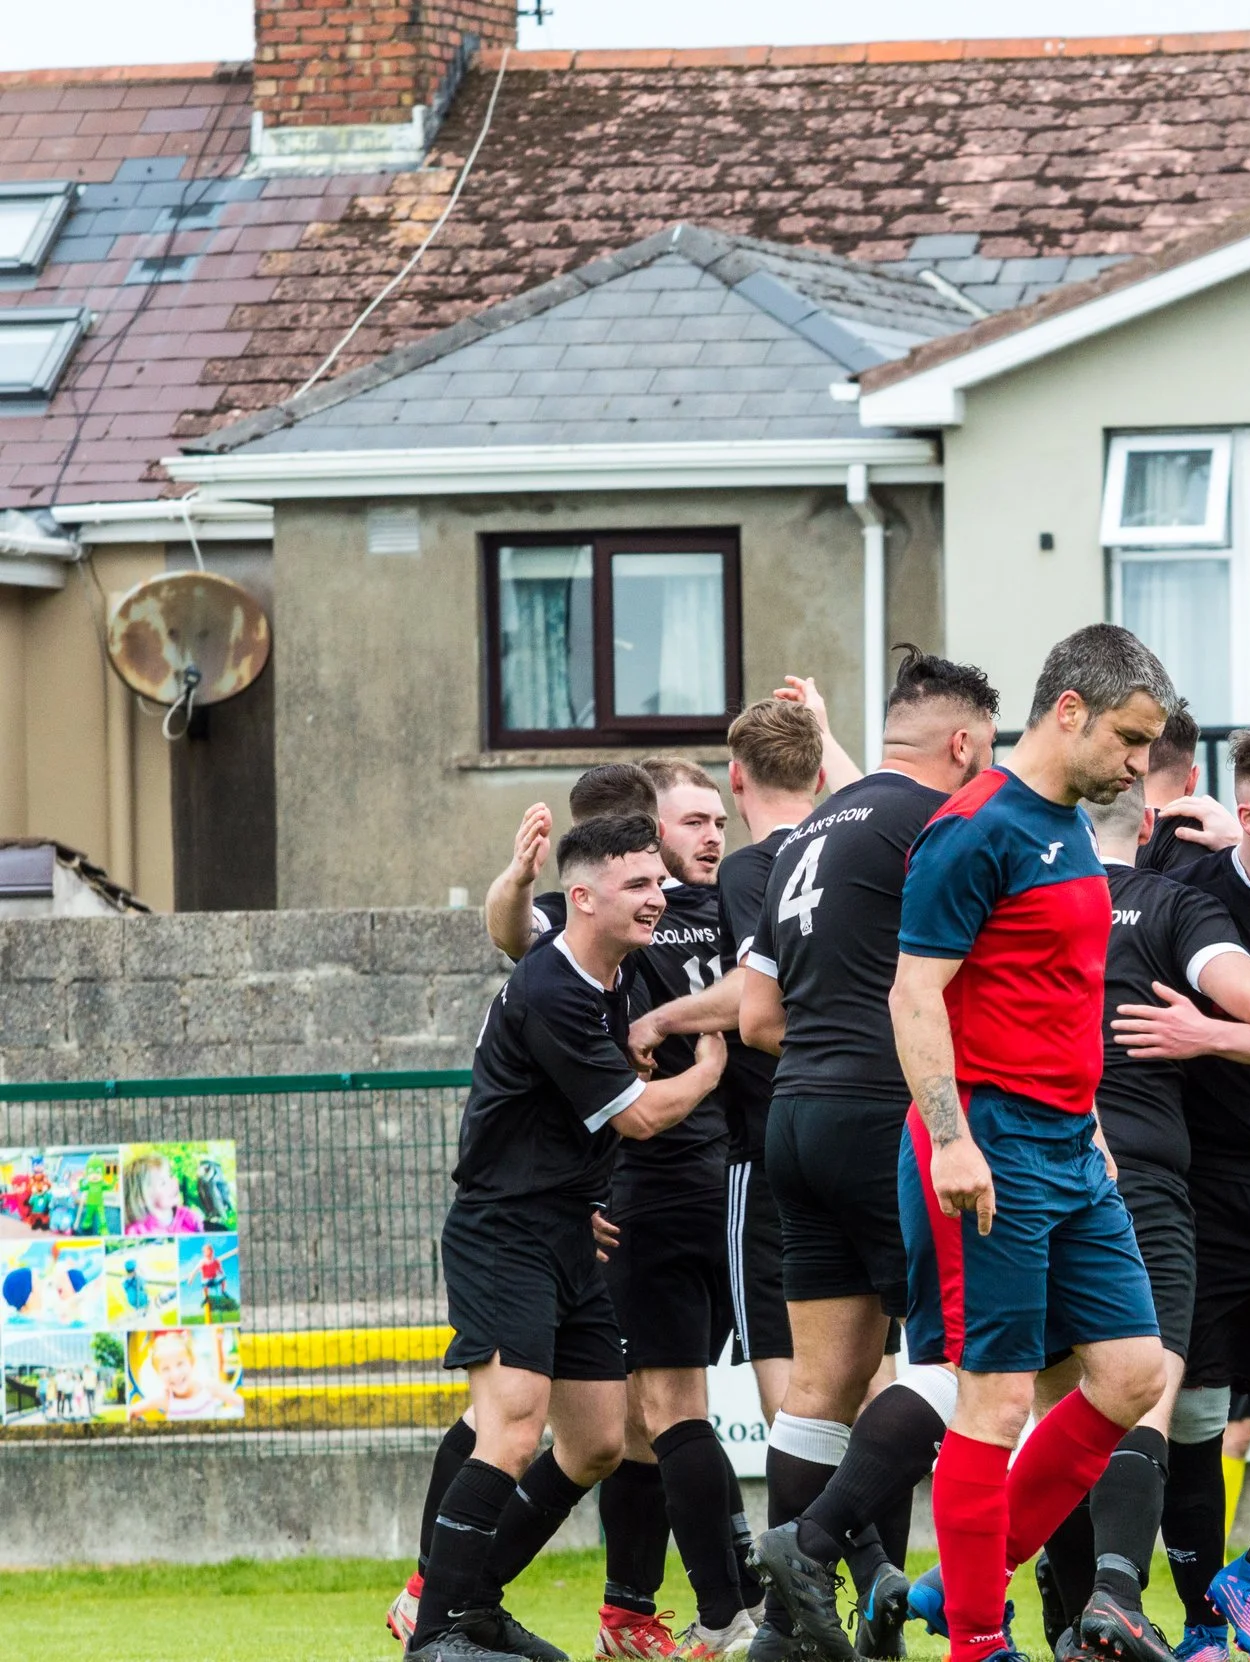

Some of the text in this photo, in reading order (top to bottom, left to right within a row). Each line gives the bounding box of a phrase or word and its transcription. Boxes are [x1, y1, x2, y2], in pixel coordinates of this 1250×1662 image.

[836, 808, 874, 823] COW
[778, 835, 827, 937] 4
[1111, 909, 1142, 926] OW
[649, 927, 716, 946] OOLAN'S
